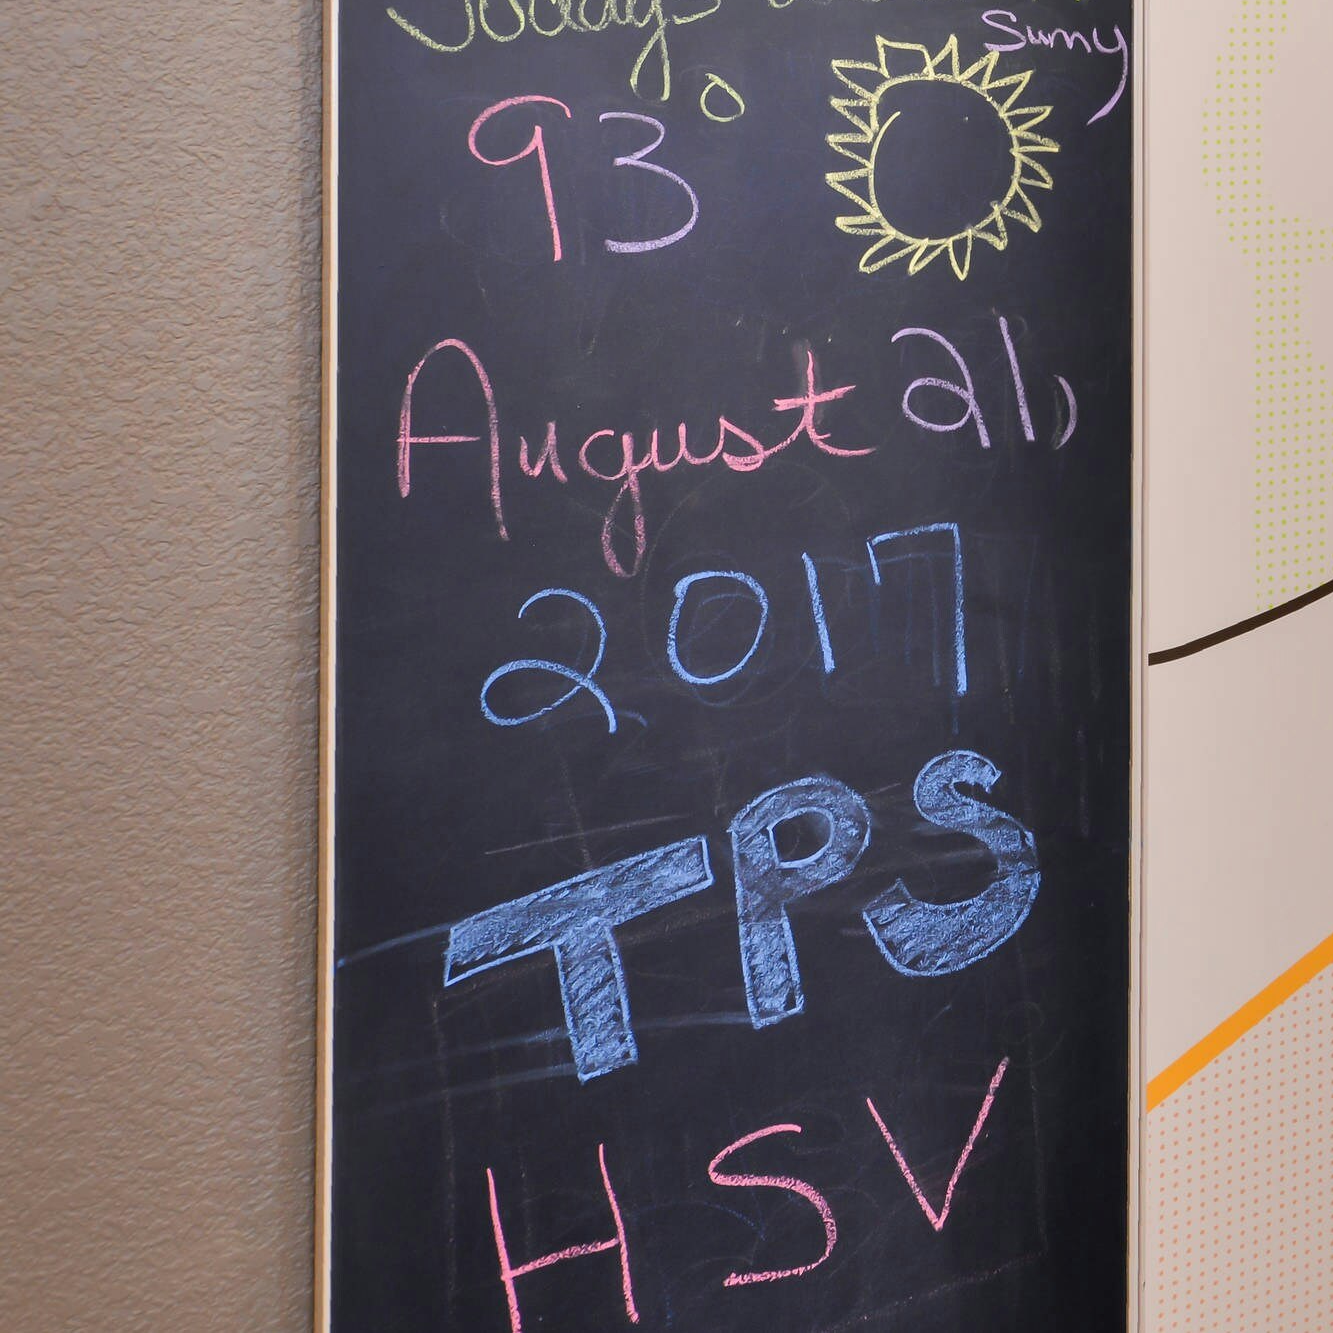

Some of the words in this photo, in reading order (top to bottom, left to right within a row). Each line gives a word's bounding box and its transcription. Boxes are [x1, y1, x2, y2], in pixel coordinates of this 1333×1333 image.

[396, 339, 878, 578] August
[481, 523, 968, 732] 2017
[444, 749, 1041, 1085] TPS
[487, 1056, 1010, 1333] HSV
